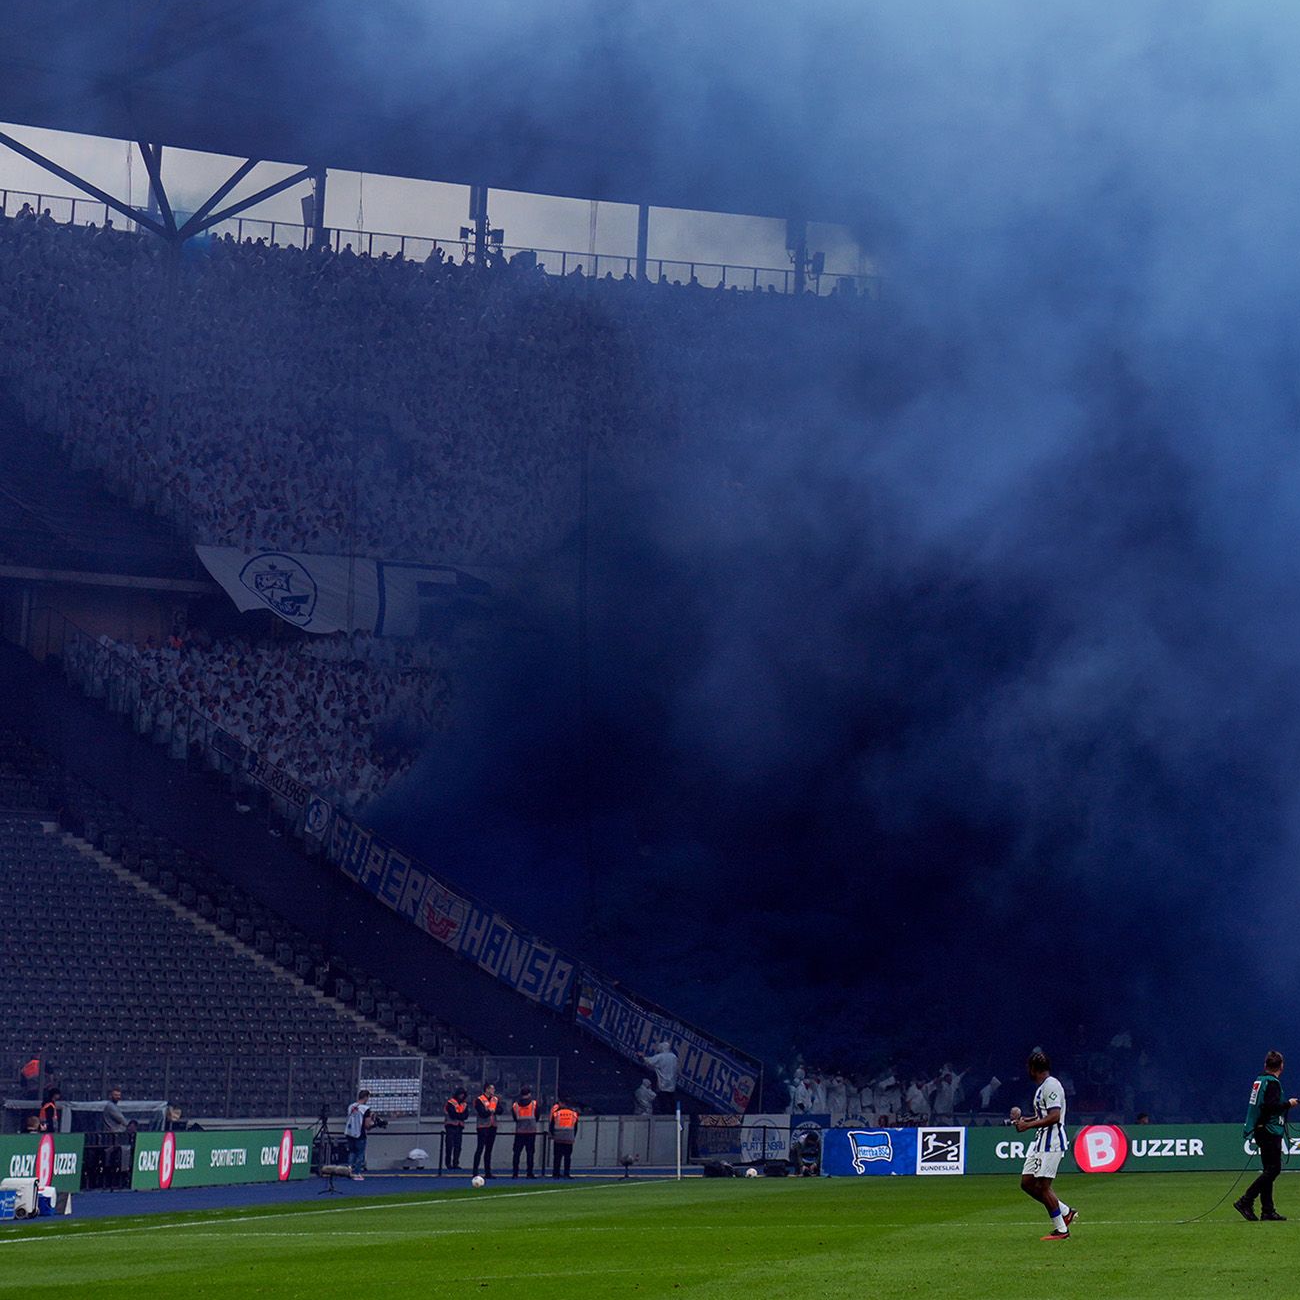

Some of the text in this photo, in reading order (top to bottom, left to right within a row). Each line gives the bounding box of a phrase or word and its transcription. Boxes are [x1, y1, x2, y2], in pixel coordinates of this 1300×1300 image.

[461, 907, 576, 1008] HANSA
[10, 1154, 36, 1177] CRAZY
[138, 1151, 160, 1172] CRAZY
[210, 1148, 247, 1167] SPORTWETTEN
[260, 1146, 279, 1165] CRAZY
